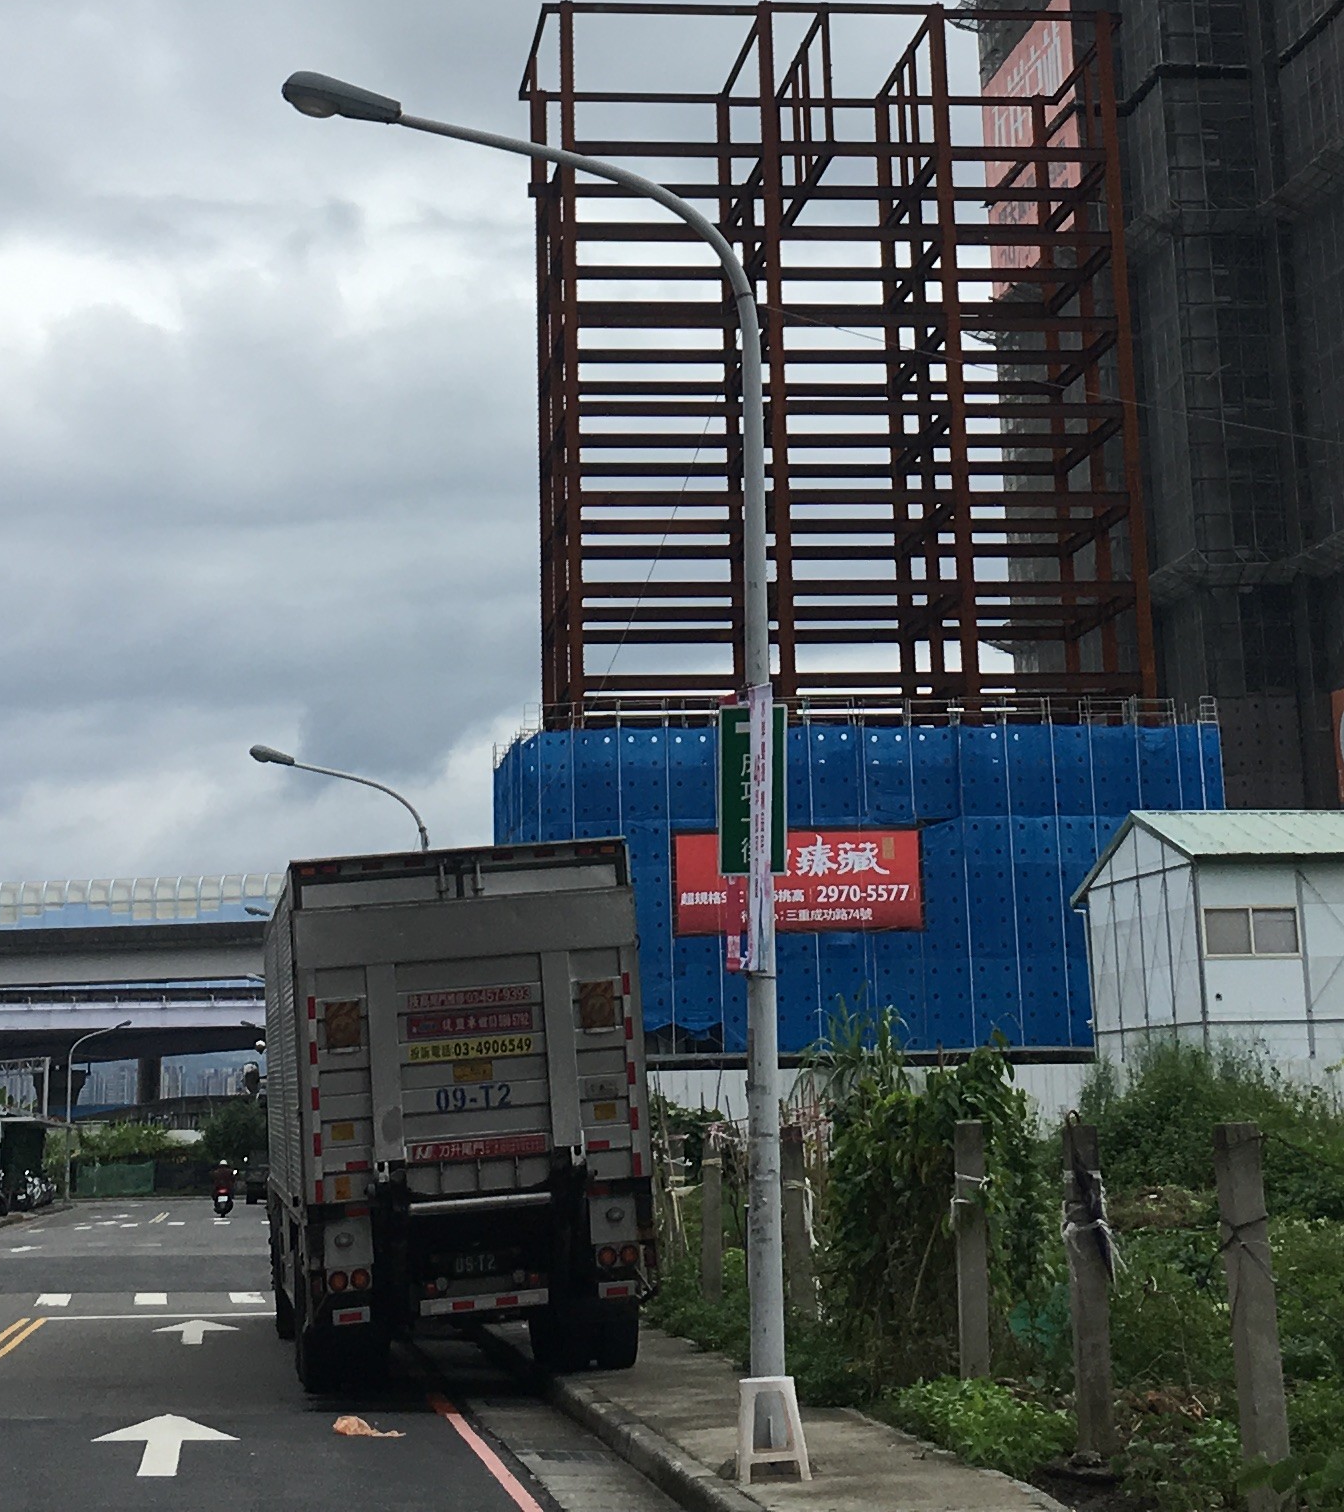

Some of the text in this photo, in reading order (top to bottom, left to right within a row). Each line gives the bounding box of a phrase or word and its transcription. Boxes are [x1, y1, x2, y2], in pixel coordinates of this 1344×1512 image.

[787, 834, 891, 877] 臻藏
[817, 884, 909, 902] 2970-5577
[436, 1083, 512, 1113] 09-T2
